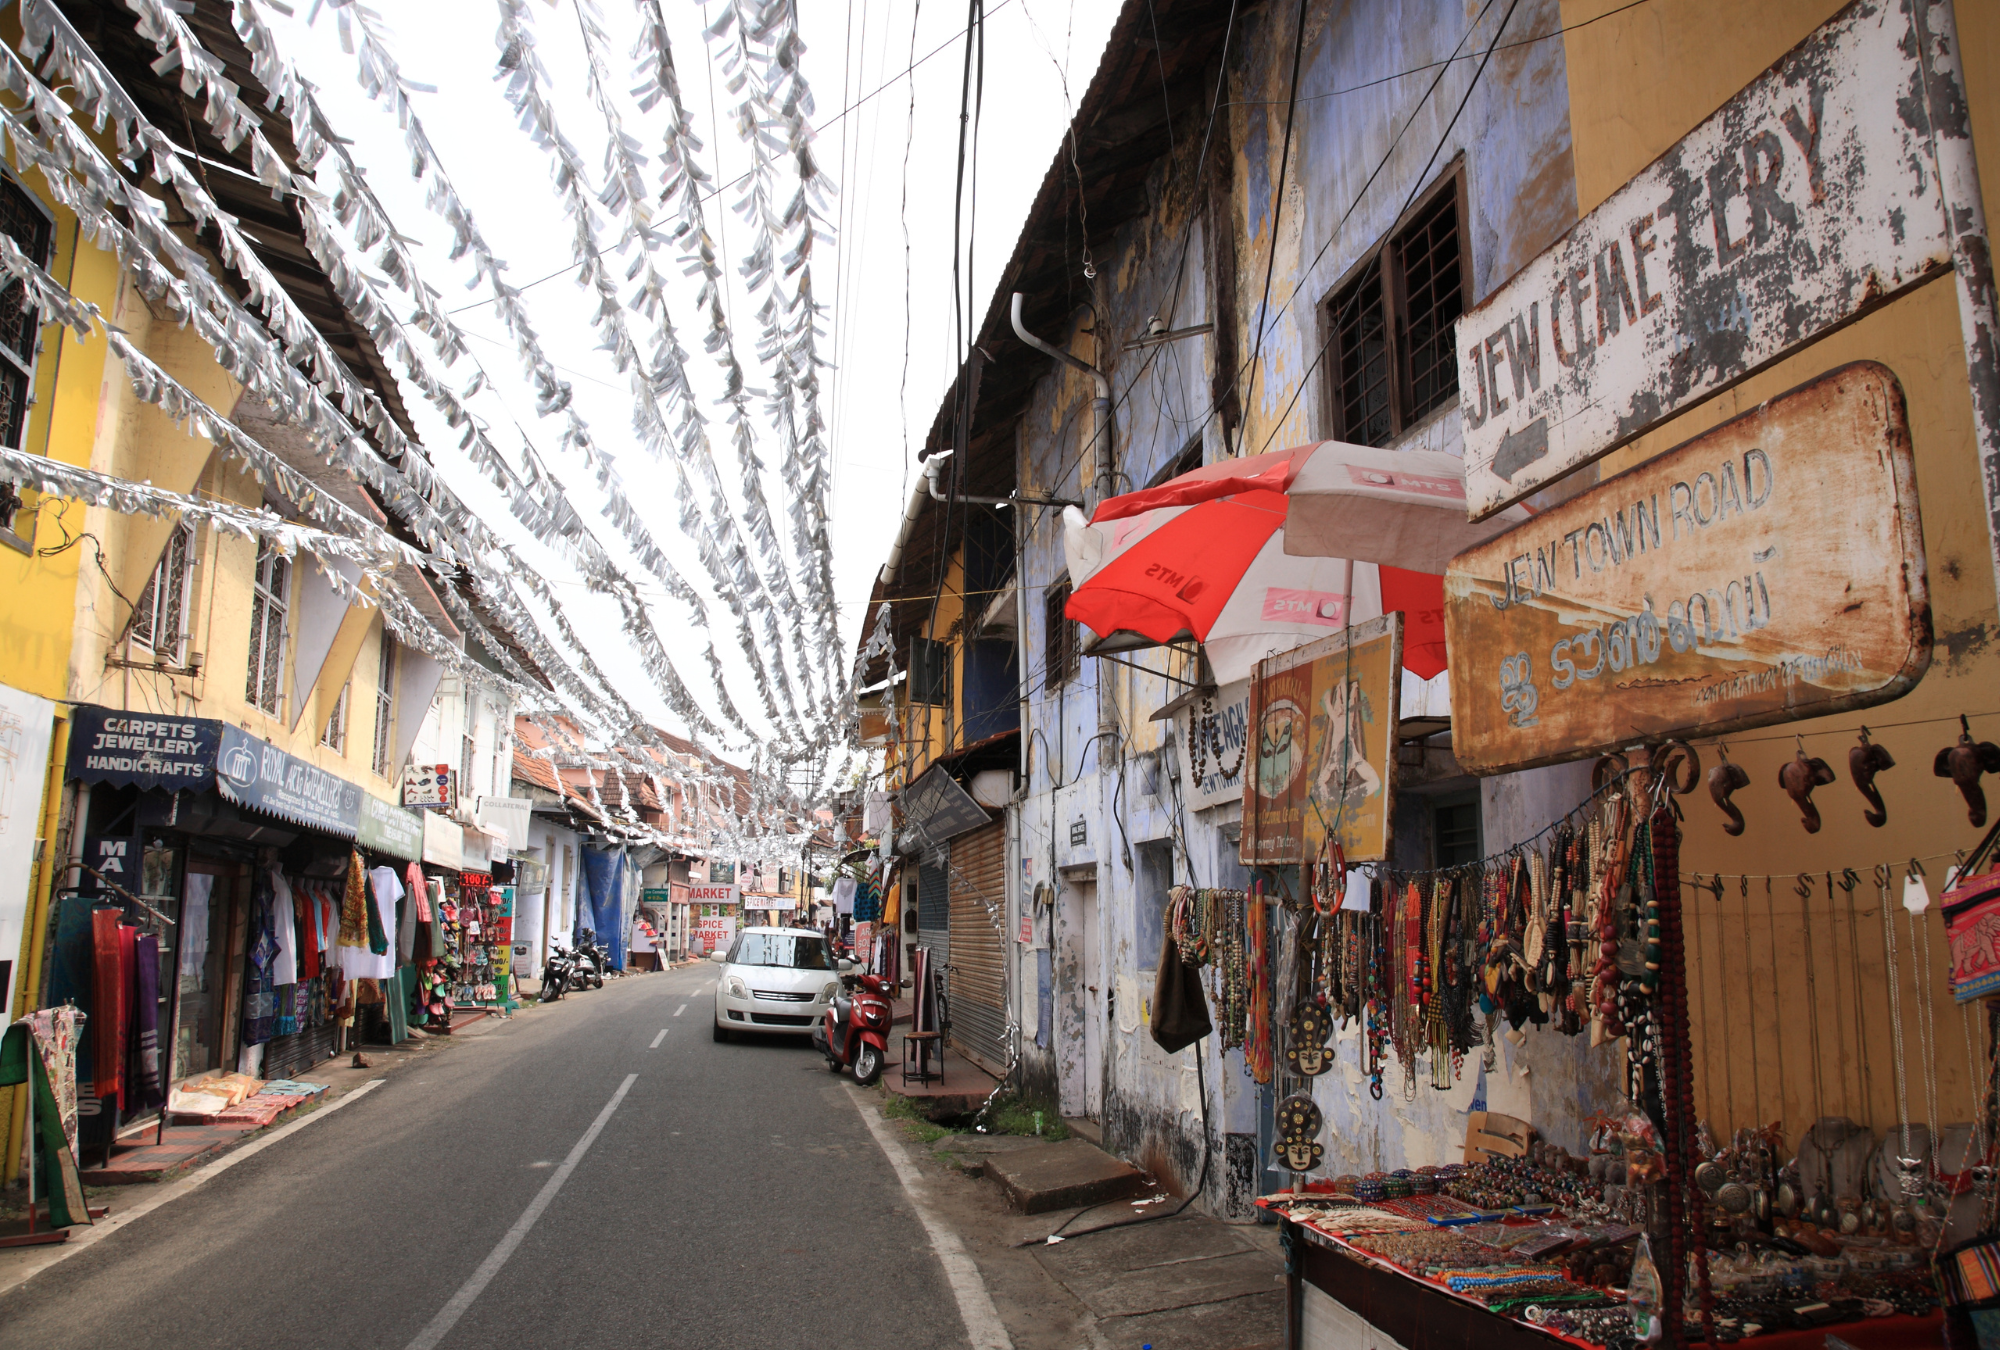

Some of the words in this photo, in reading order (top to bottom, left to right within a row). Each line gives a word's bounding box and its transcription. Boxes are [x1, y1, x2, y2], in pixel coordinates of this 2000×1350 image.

[1465, 301, 1541, 430] JEW
[1401, 479, 1451, 491] MTS
[1488, 540, 1556, 611] JEW
[1563, 493, 1661, 579] TOWN
[1669, 448, 1773, 540] ROAD
[103, 718, 197, 739] CARPETS
[92, 733, 203, 756] JEWELLERY
[86, 755, 205, 778] HANDICRAFTS
[261, 745, 286, 787] ROYAL
[484, 801, 529, 811] COLLATERAL
[689, 887, 732, 899] MARKET
[746, 897, 760, 907] SPICE
[698, 920, 723, 928] SPICE
[694, 930, 729, 939] MARKET
